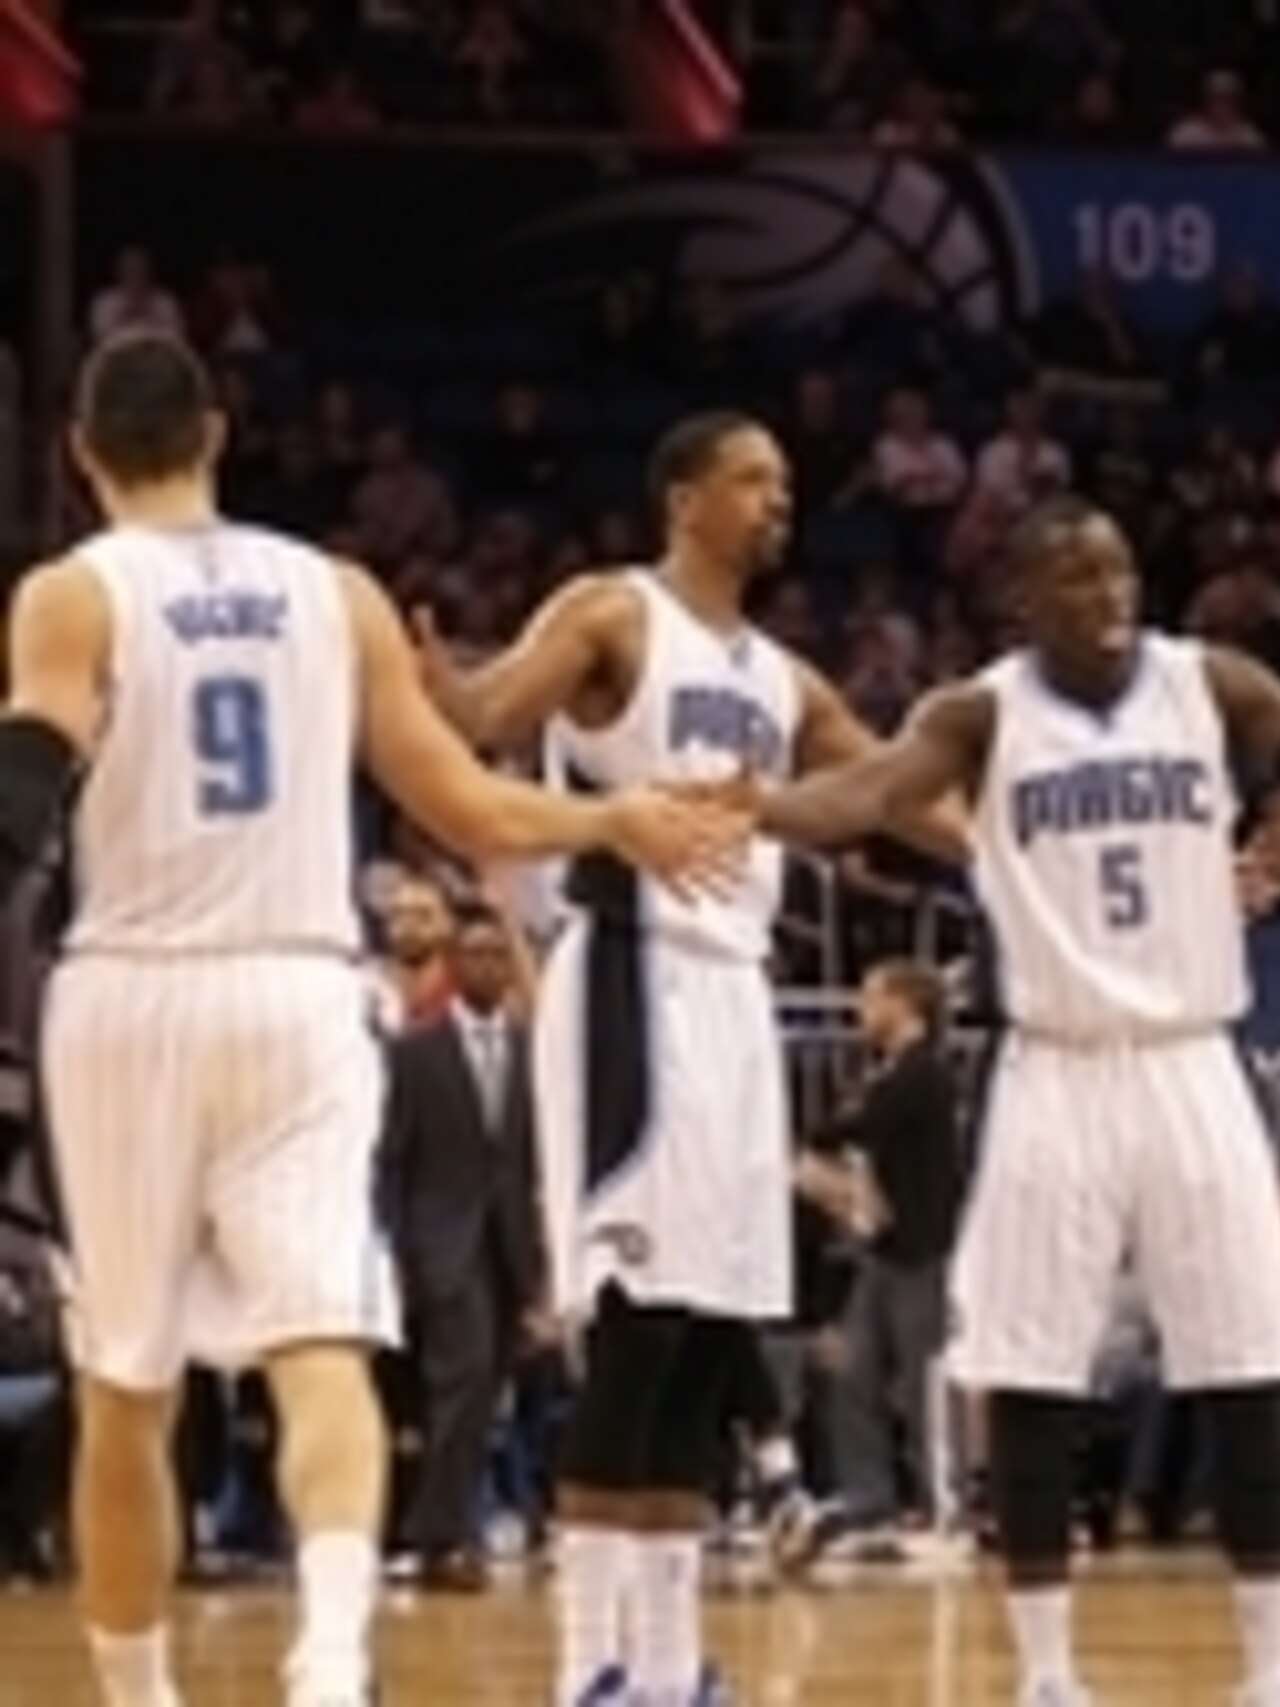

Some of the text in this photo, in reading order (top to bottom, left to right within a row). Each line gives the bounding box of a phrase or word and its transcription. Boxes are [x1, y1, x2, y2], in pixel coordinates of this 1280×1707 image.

[1074, 203, 1217, 280] 109
[191, 676, 271, 820] 9
[1010, 757, 1212, 850] MAGIC
[1099, 845, 1148, 930] 5
